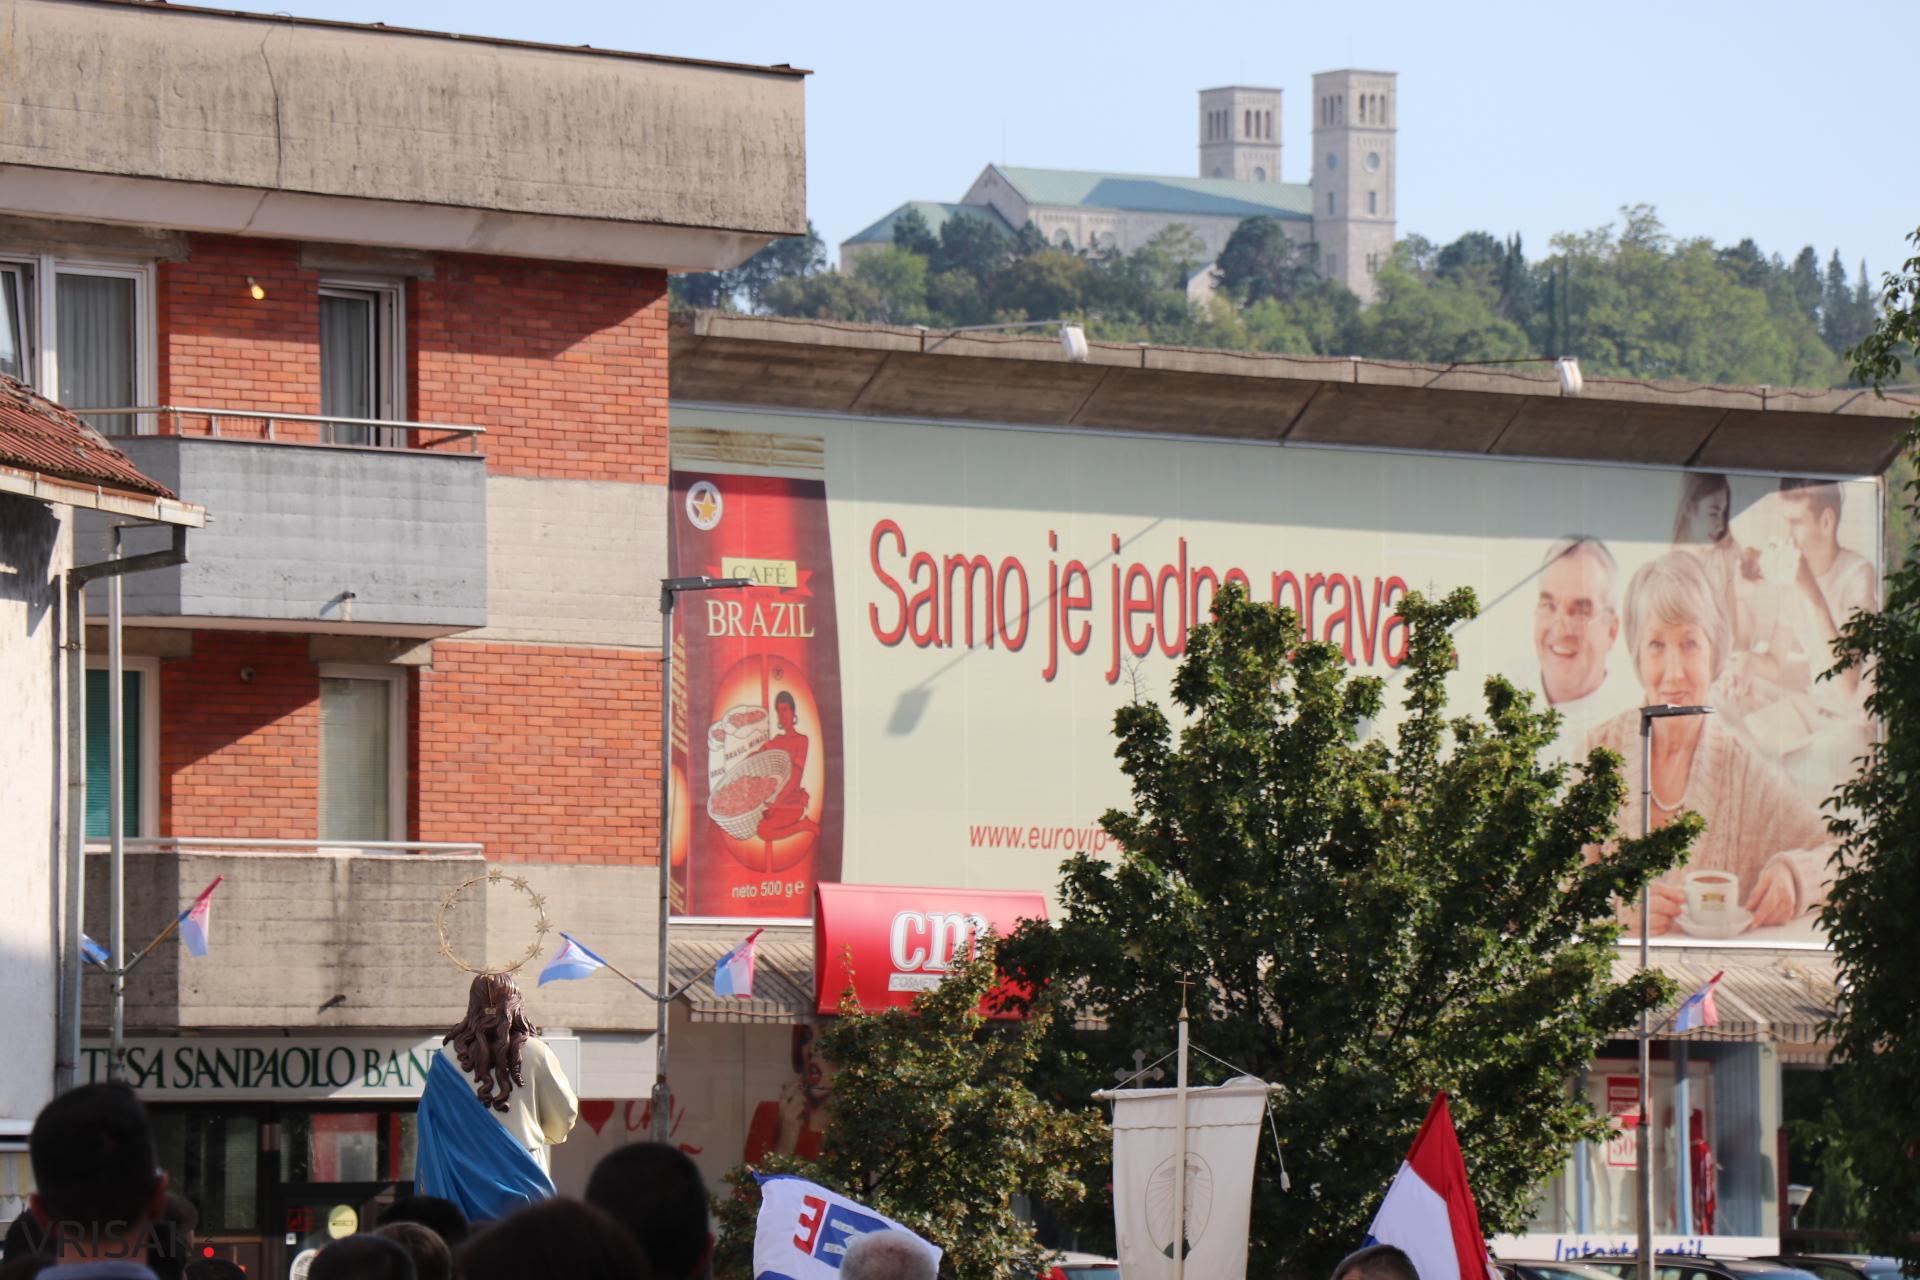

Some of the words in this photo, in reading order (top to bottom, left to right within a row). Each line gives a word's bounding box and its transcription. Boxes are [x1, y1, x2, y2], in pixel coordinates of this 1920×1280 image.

[732, 562, 788, 584] CAFÉ
[705, 599, 815, 638] BRAZIL
[869, 518, 1030, 652] Samo
[1042, 529, 1093, 682] je
[1105, 533, 1250, 684] jedn
[969, 820, 1125, 857] www.eurovip-
[731, 884, 758, 899] neto
[760, 880, 782, 897] 500
[173, 1046, 355, 1088] SANPAOLO
